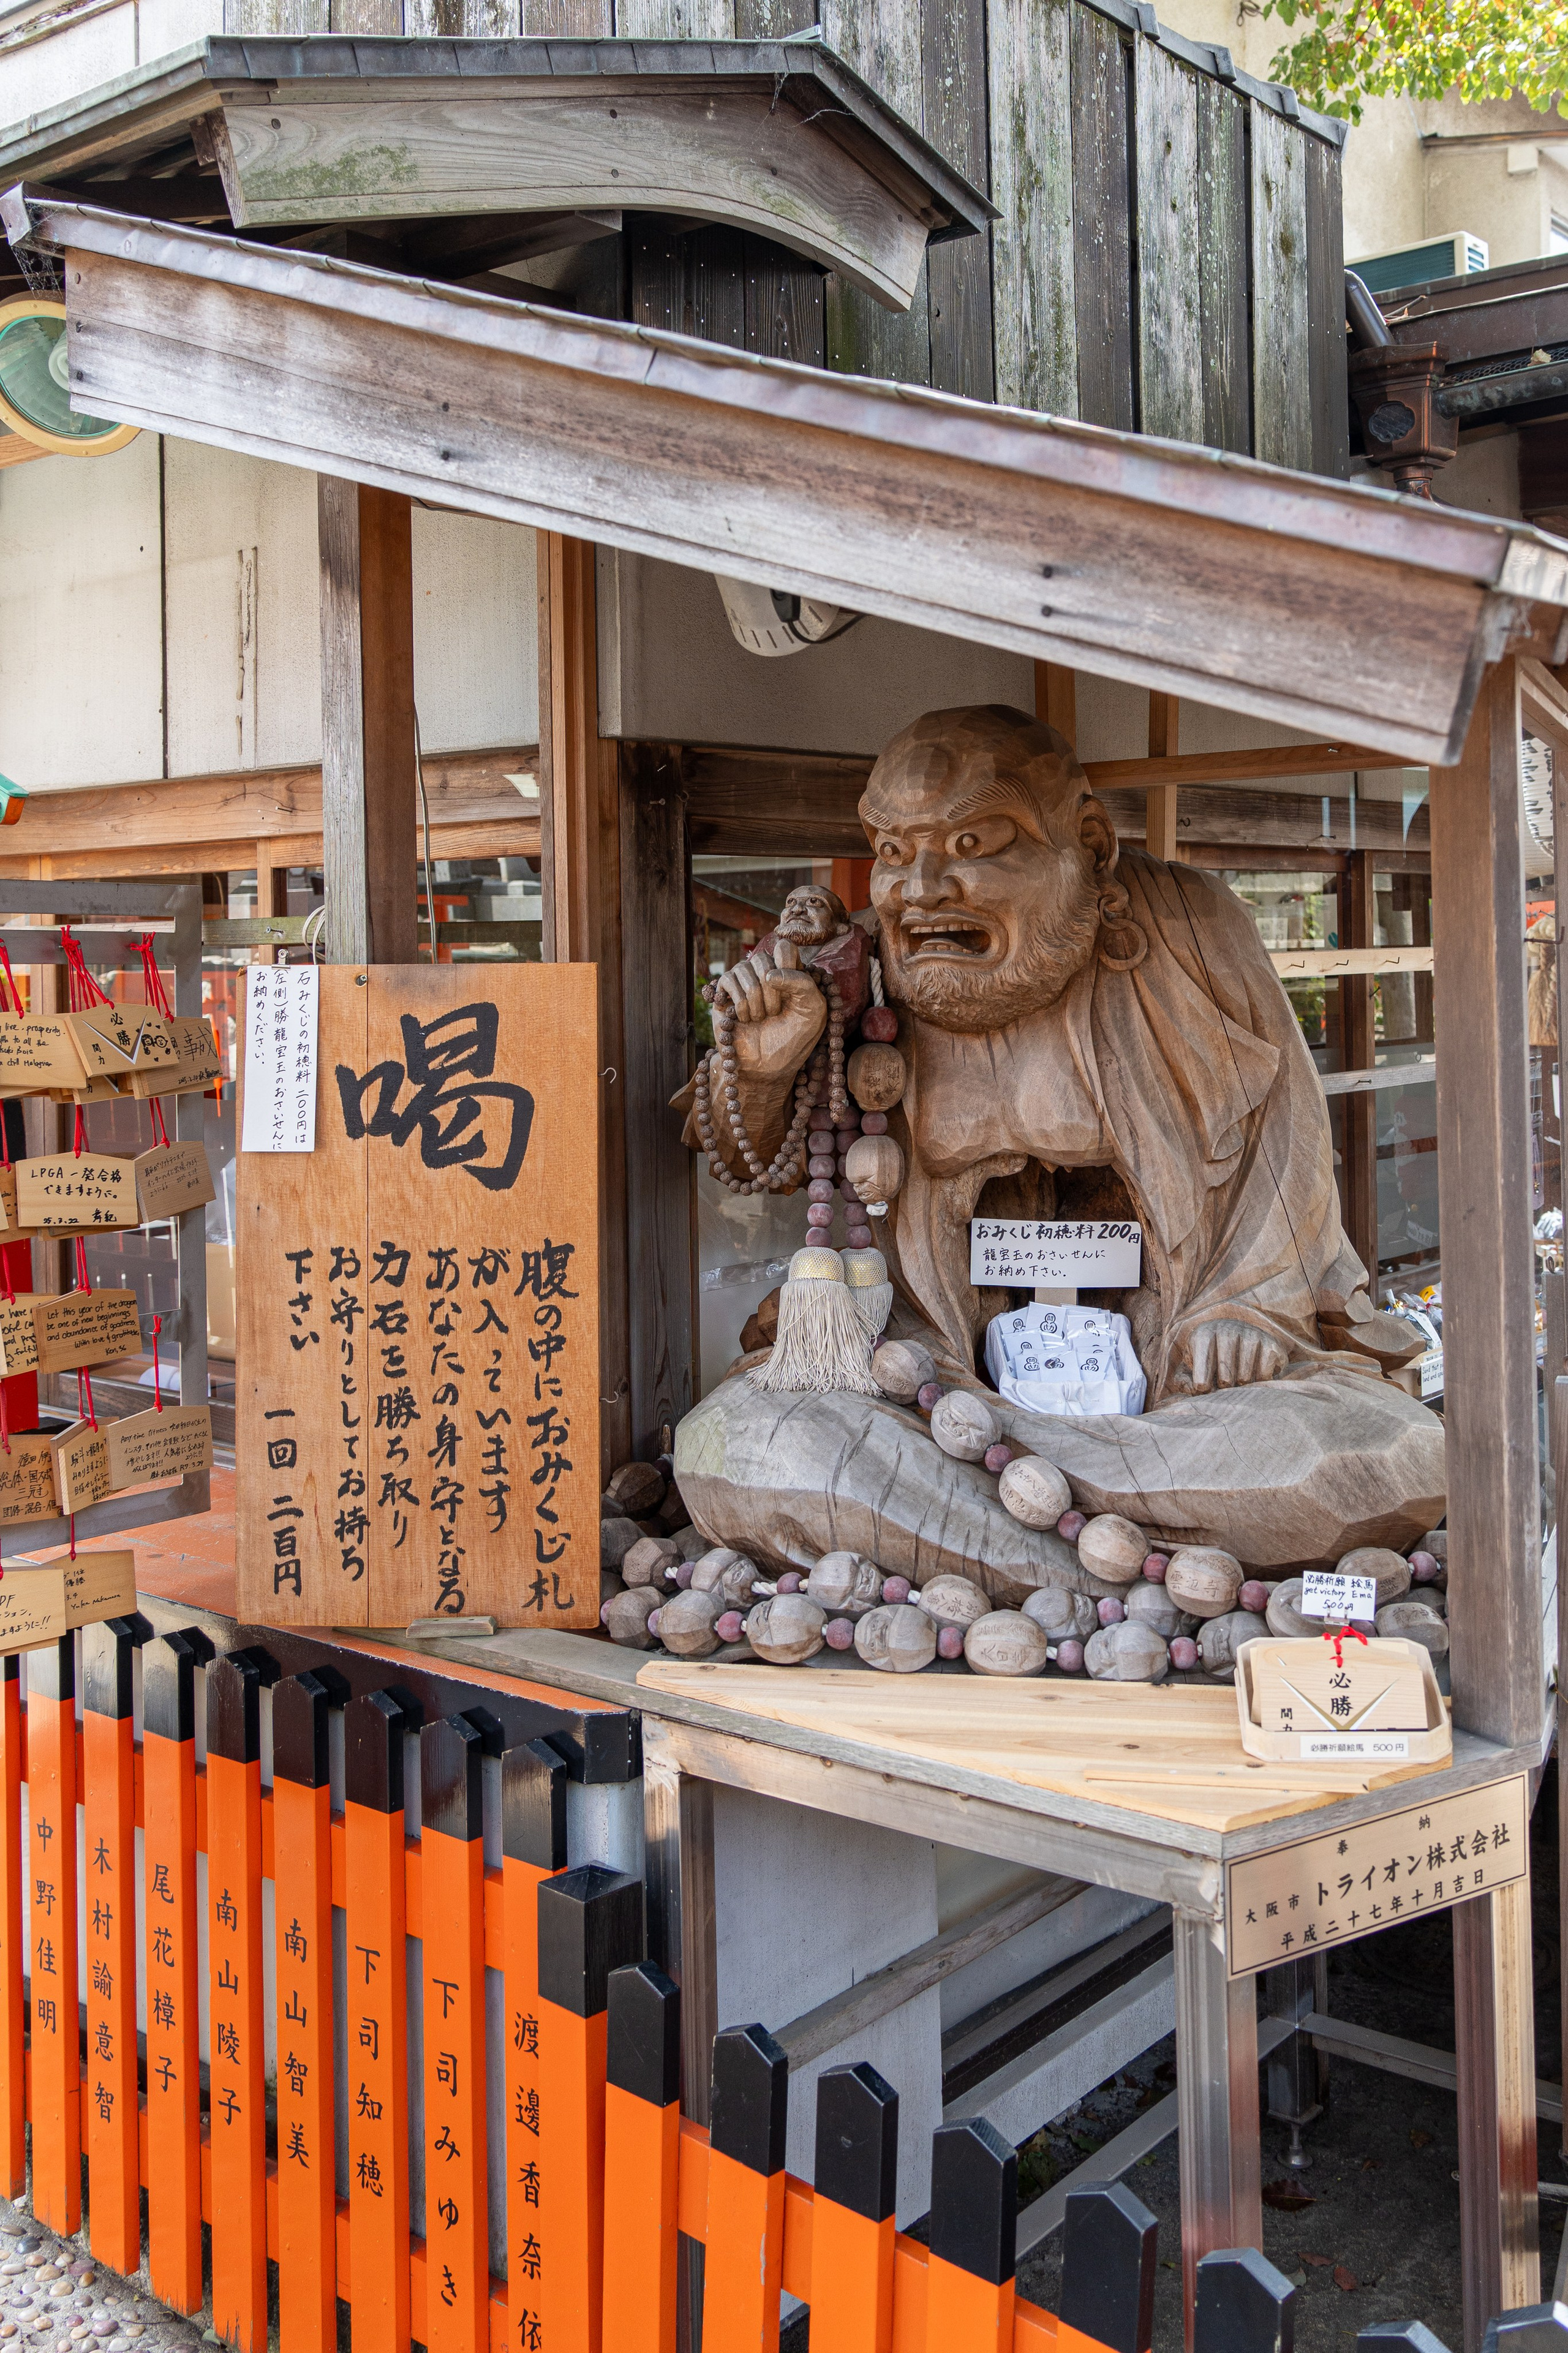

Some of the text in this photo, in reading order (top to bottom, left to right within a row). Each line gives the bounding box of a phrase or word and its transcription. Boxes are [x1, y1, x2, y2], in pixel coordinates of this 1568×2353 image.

[110, 1012, 131, 1046] 必勝
[295, 971, 312, 1084] 石みくじの初穂料
[334, 1001, 535, 1192] 喝
[31, 1167, 122, 1183] LPGA 一発合格
[44, 1184, 118, 1199] できますように。
[285, 1248, 319, 1350] 下さい
[983, 1247, 1106, 1261] 龍宝玉のおさいせんに
[9, 1309, 28, 1319] have
[47, 1309, 59, 1320] Let
[62, 1307, 75, 1317] this
[79, 1306, 92, 1317] year
[95, 1301, 104, 1312] of
[118, 1299, 137, 1308] dragon
[47, 1332, 60, 1341] and
[62, 1326, 98, 1339] abundance
[110, 1319, 137, 1332] goodness.
[72, 1318, 79, 1327] of
[97, 1310, 130, 1323] beginnings
[74, 1339, 89, 1348] With
[328, 1246, 372, 1582] お守りとしてお持ち
[369, 1241, 422, 1548] 力石を勝ち取り
[425, 1247, 467, 1614] あなたの身守となる
[467, 1246, 514, 1533] が入っています
[515, 1241, 581, 1611] 腹の中におみくじ札
[264, 1409, 304, 1596] 一回 二百円
[1304, 1587, 1318, 1595] get
[1320, 1588, 1346, 1601] victory
[1305, 1574, 1345, 1587] 必勝祈願
[1351, 1578, 1373, 1591] 絵馬
[1329, 1672, 1354, 1717] 必勝
[1310, 1743, 1365, 1752] 必勝祈願絵馬
[1245, 1822, 1511, 1925] 大阪市 トライオン株式会社
[1336, 1814, 1431, 1856] 奉 納
[37, 1816, 56, 2034] 中野佳明
[1281, 1868, 1484, 1951] 平成二十七年十月吉日
[92, 1837, 113, 2124] 木村諭意智
[152, 1863, 177, 2093] 尾花樟子
[216, 1888, 241, 2126] 南山陵子
[285, 1918, 309, 2169] 南山智美
[355, 1945, 383, 2198] 下司知穂
[432, 1977, 461, 2308] 下司みゆき
